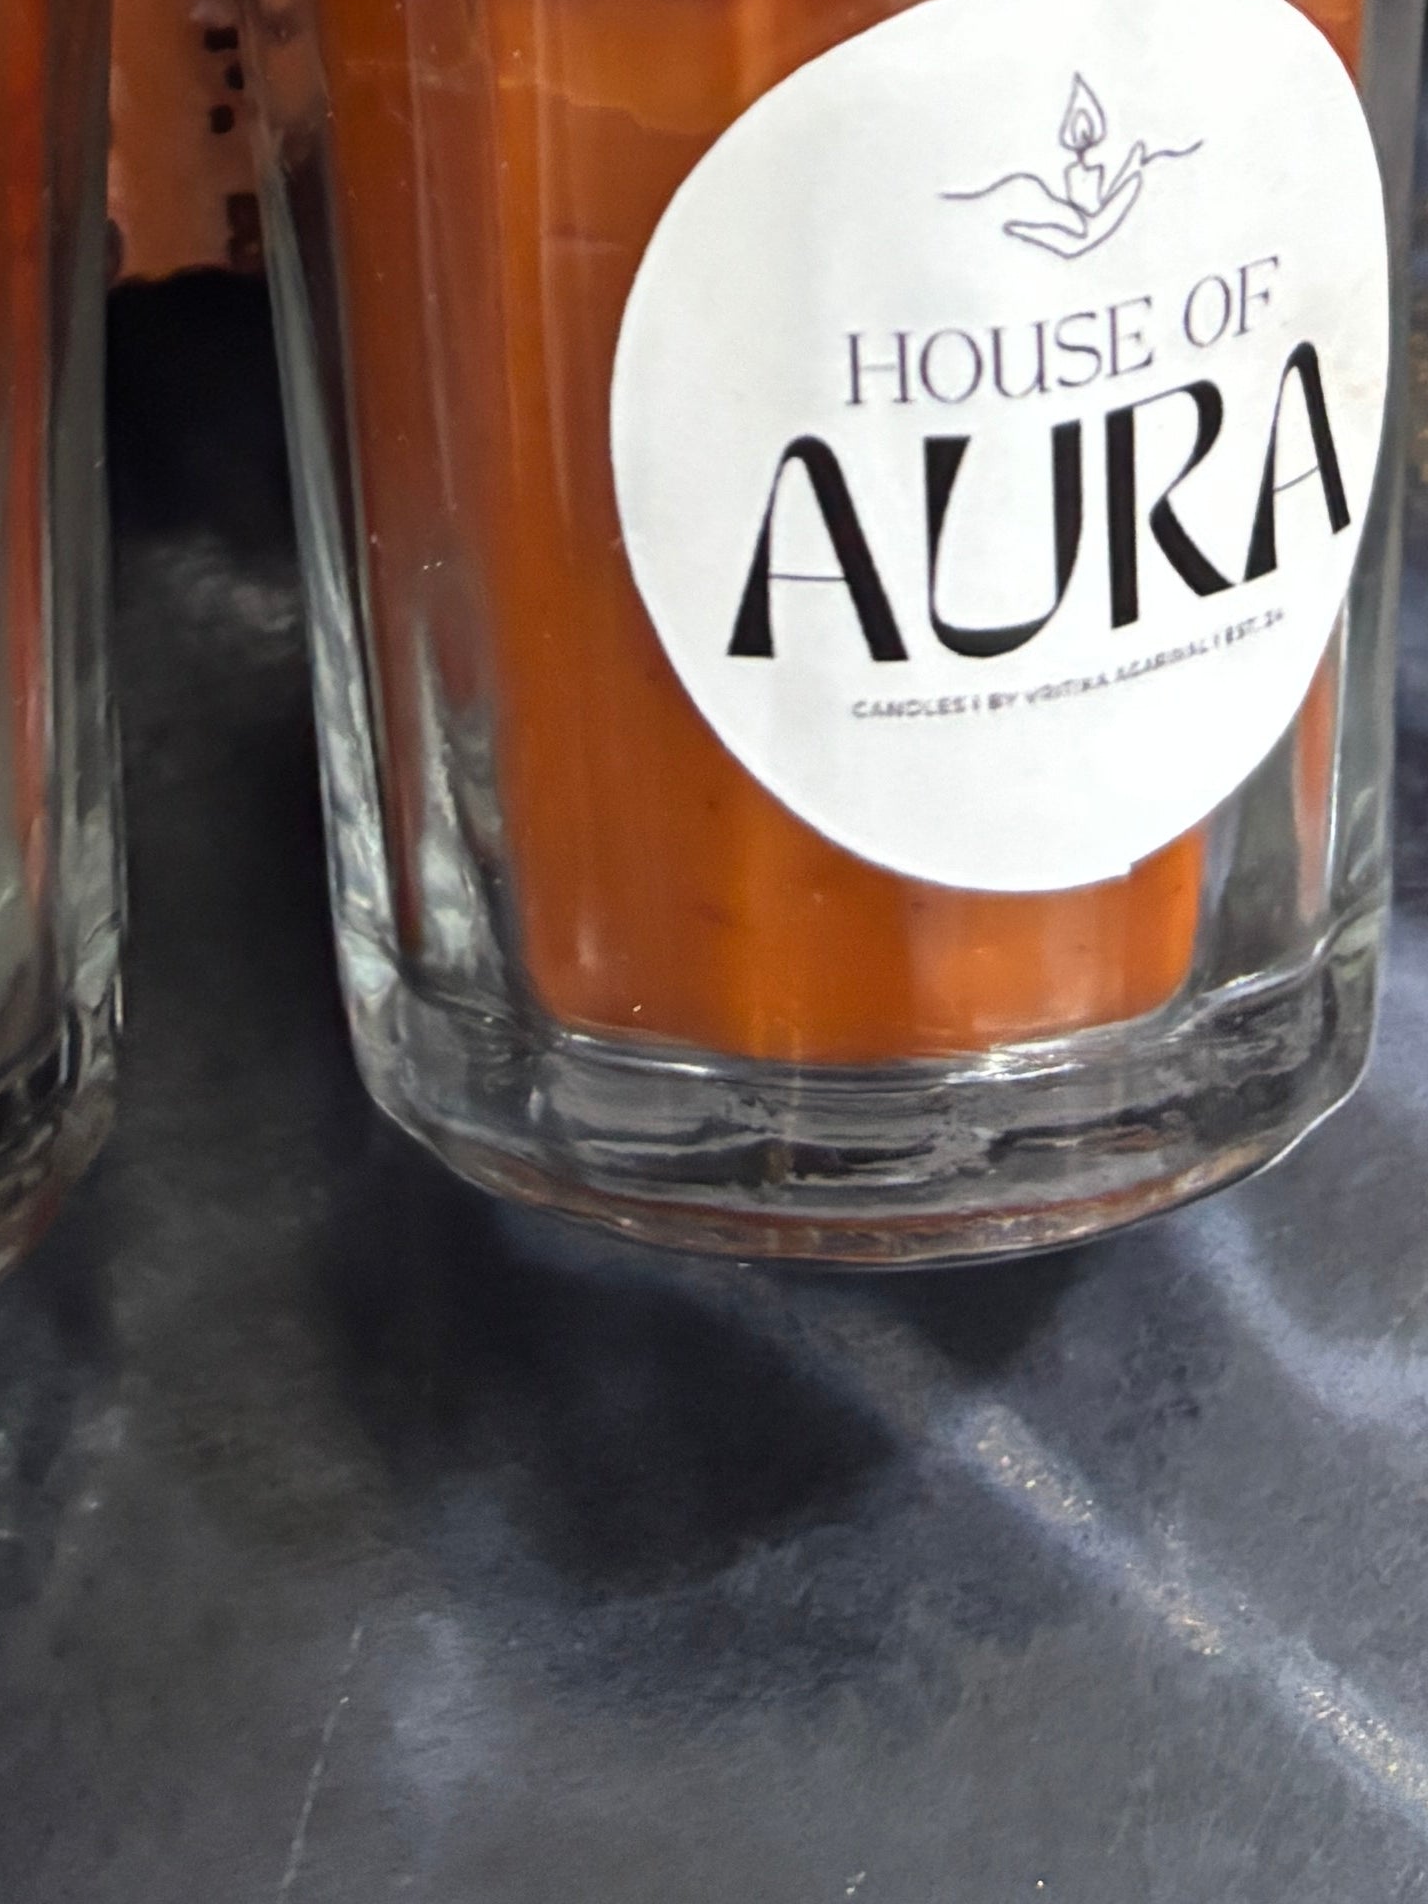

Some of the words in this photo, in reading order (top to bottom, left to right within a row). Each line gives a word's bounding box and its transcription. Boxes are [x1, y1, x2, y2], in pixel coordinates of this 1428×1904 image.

[843, 295, 1157, 408] HOUSE
[1180, 254, 1282, 349] OF
[726, 339, 1352, 663] AURA
[852, 694, 966, 718] CANDLES
